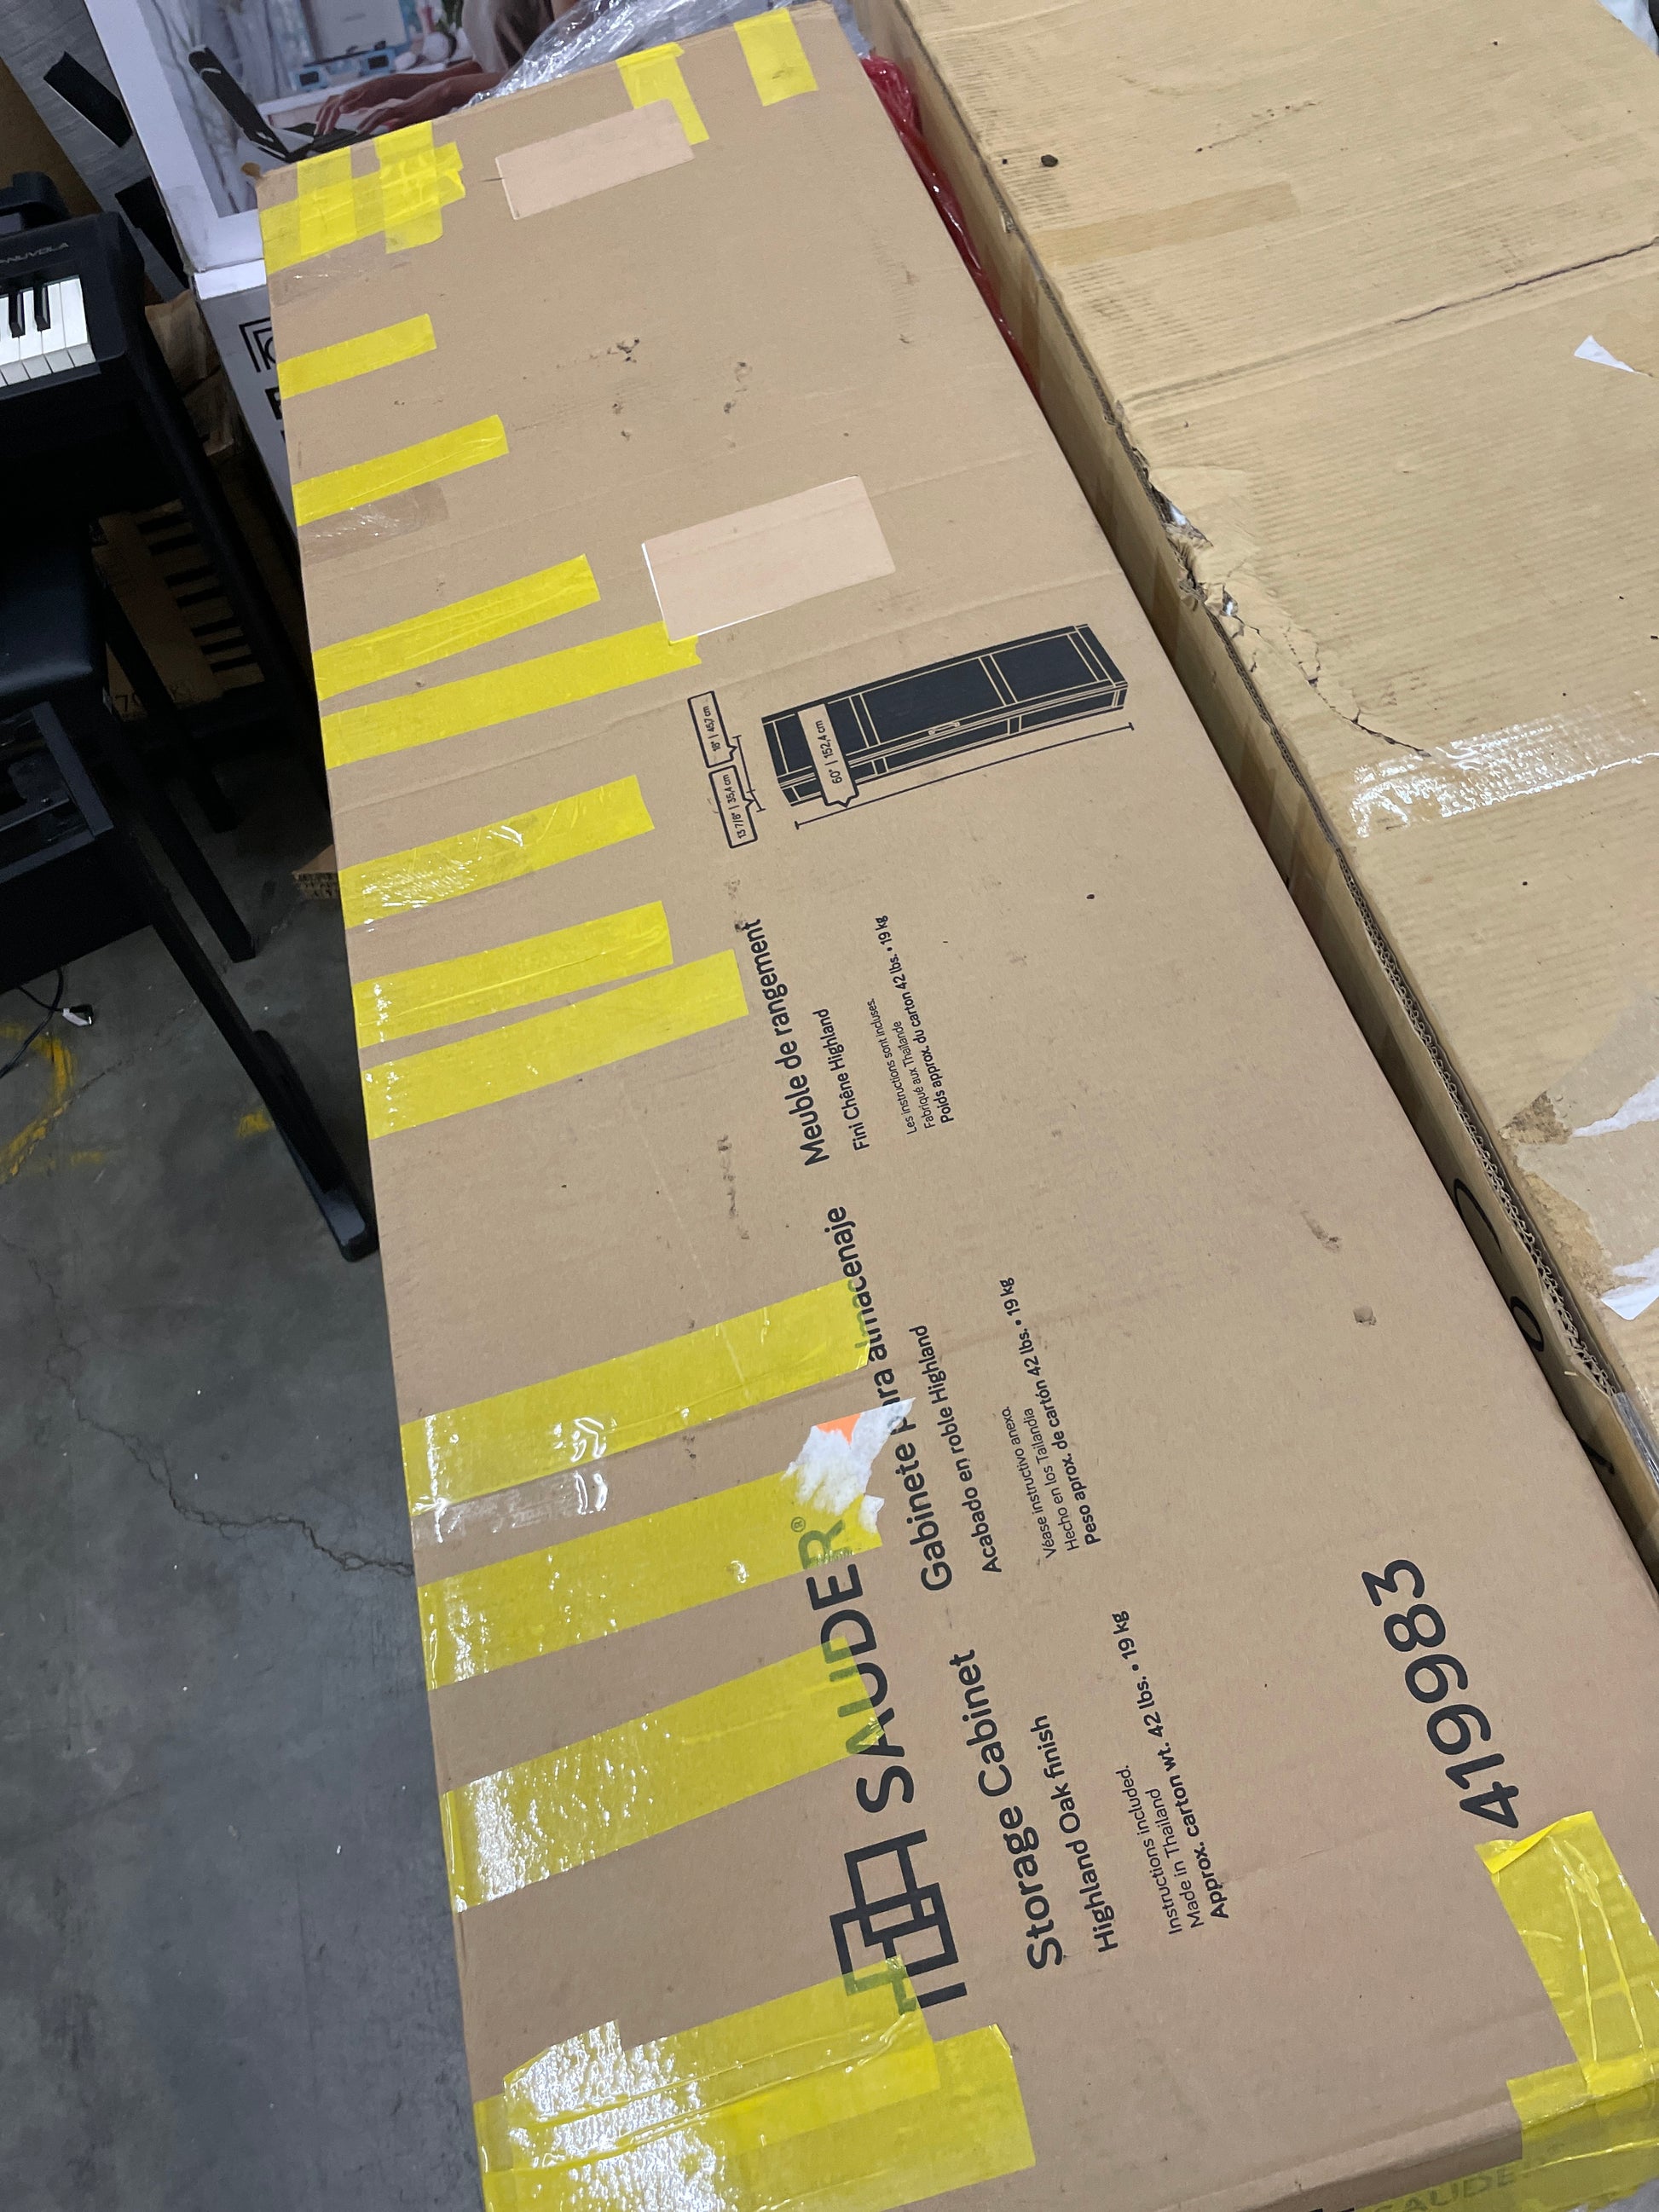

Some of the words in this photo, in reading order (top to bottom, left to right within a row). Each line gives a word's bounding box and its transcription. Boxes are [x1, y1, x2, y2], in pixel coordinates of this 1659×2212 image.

[702, 706, 711, 717] cm
[815, 720, 826, 734] cm
[817, 734, 835, 759] 152,4
[723, 774, 731, 786] cm
[737, 829, 747, 840] 13
[875, 915, 889, 932] kg
[877, 931, 893, 945] 19
[744, 919, 792, 1036] rangement
[888, 953, 903, 974] lbs.
[892, 973, 908, 990] 42
[867, 998, 885, 1037] incluses.
[902, 992, 921, 1027] carton
[775, 1041, 801, 1069] de
[812, 1009, 845, 1071] Highland
[877, 1037, 893, 1059] sont
[912, 1029, 928, 1044] du
[908, 1066, 922, 1085] aux
[921, 1045, 943, 1088] approx.
[837, 1072, 859, 1120] Chêne
[887, 1060, 910, 1115] instructions
[933, 1090, 954, 1123] Poids
[785, 1075, 830, 1165] Meuble
[905, 1115, 918, 1135] Les
[913, 1086, 935, 1129] Fabriqué
[848, 1122, 870, 1151] Fini
[824, 1207, 887, 1362] almacenaje
[998, 1277, 1015, 1297] kg
[1003, 1298, 1021, 1317] 19
[1019, 1328, 1034, 1354] lbs.
[909, 1325, 948, 1404] Highland
[1023, 1354, 1042, 1377] 42
[874, 1369, 916, 1435] pra
[1035, 1380, 1060, 1427] cartón
[937, 1406, 964, 1453] roble
[1002, 1406, 1020, 1445] anexo.
[1024, 1408, 1049, 1464] Tailandia
[1050, 1430, 1068, 1450] de
[956, 1458, 972, 1481] en
[1014, 1448, 1043, 1515] instructivo
[1043, 1465, 1057, 1487] los
[1062, 1453, 1087, 1500] aprox.
[1050, 1487, 1064, 1505] en
[895, 1441, 952, 1591] Gabinete
[962, 1487, 1002, 1572] Acabado
[1058, 1507, 1079, 1551] Hecho
[1079, 1505, 1101, 1545] Peso
[1038, 1516, 1056, 1558] Véase
[1112, 1611, 1129, 1634] kg
[1119, 1638, 1136, 1660] 19
[1137, 1676, 1154, 1709] lbs.
[1361, 1559, 1519, 1828] 41983
[949, 1649, 1012, 1797] Cabinet
[1144, 1712, 1164, 1737] 42
[1031, 1715, 1065, 1779] finish
[1158, 1742, 1176, 1771] wt.
[1050, 1782, 1080, 1834] Oak
[1117, 1765, 1150, 1835] included.
[1170, 1775, 1199, 1837] carton
[1145, 1789, 1180, 1859] Thailand
[999, 1806, 1062, 1969] Storage
[1143, 1839, 1182, 1934] Instructions
[1173, 1860, 1188, 1878] in
[1194, 1842, 1228, 1919] Approx.
[1065, 1839, 1118, 1952] Highland
[1179, 1880, 1204, 1928] Made
